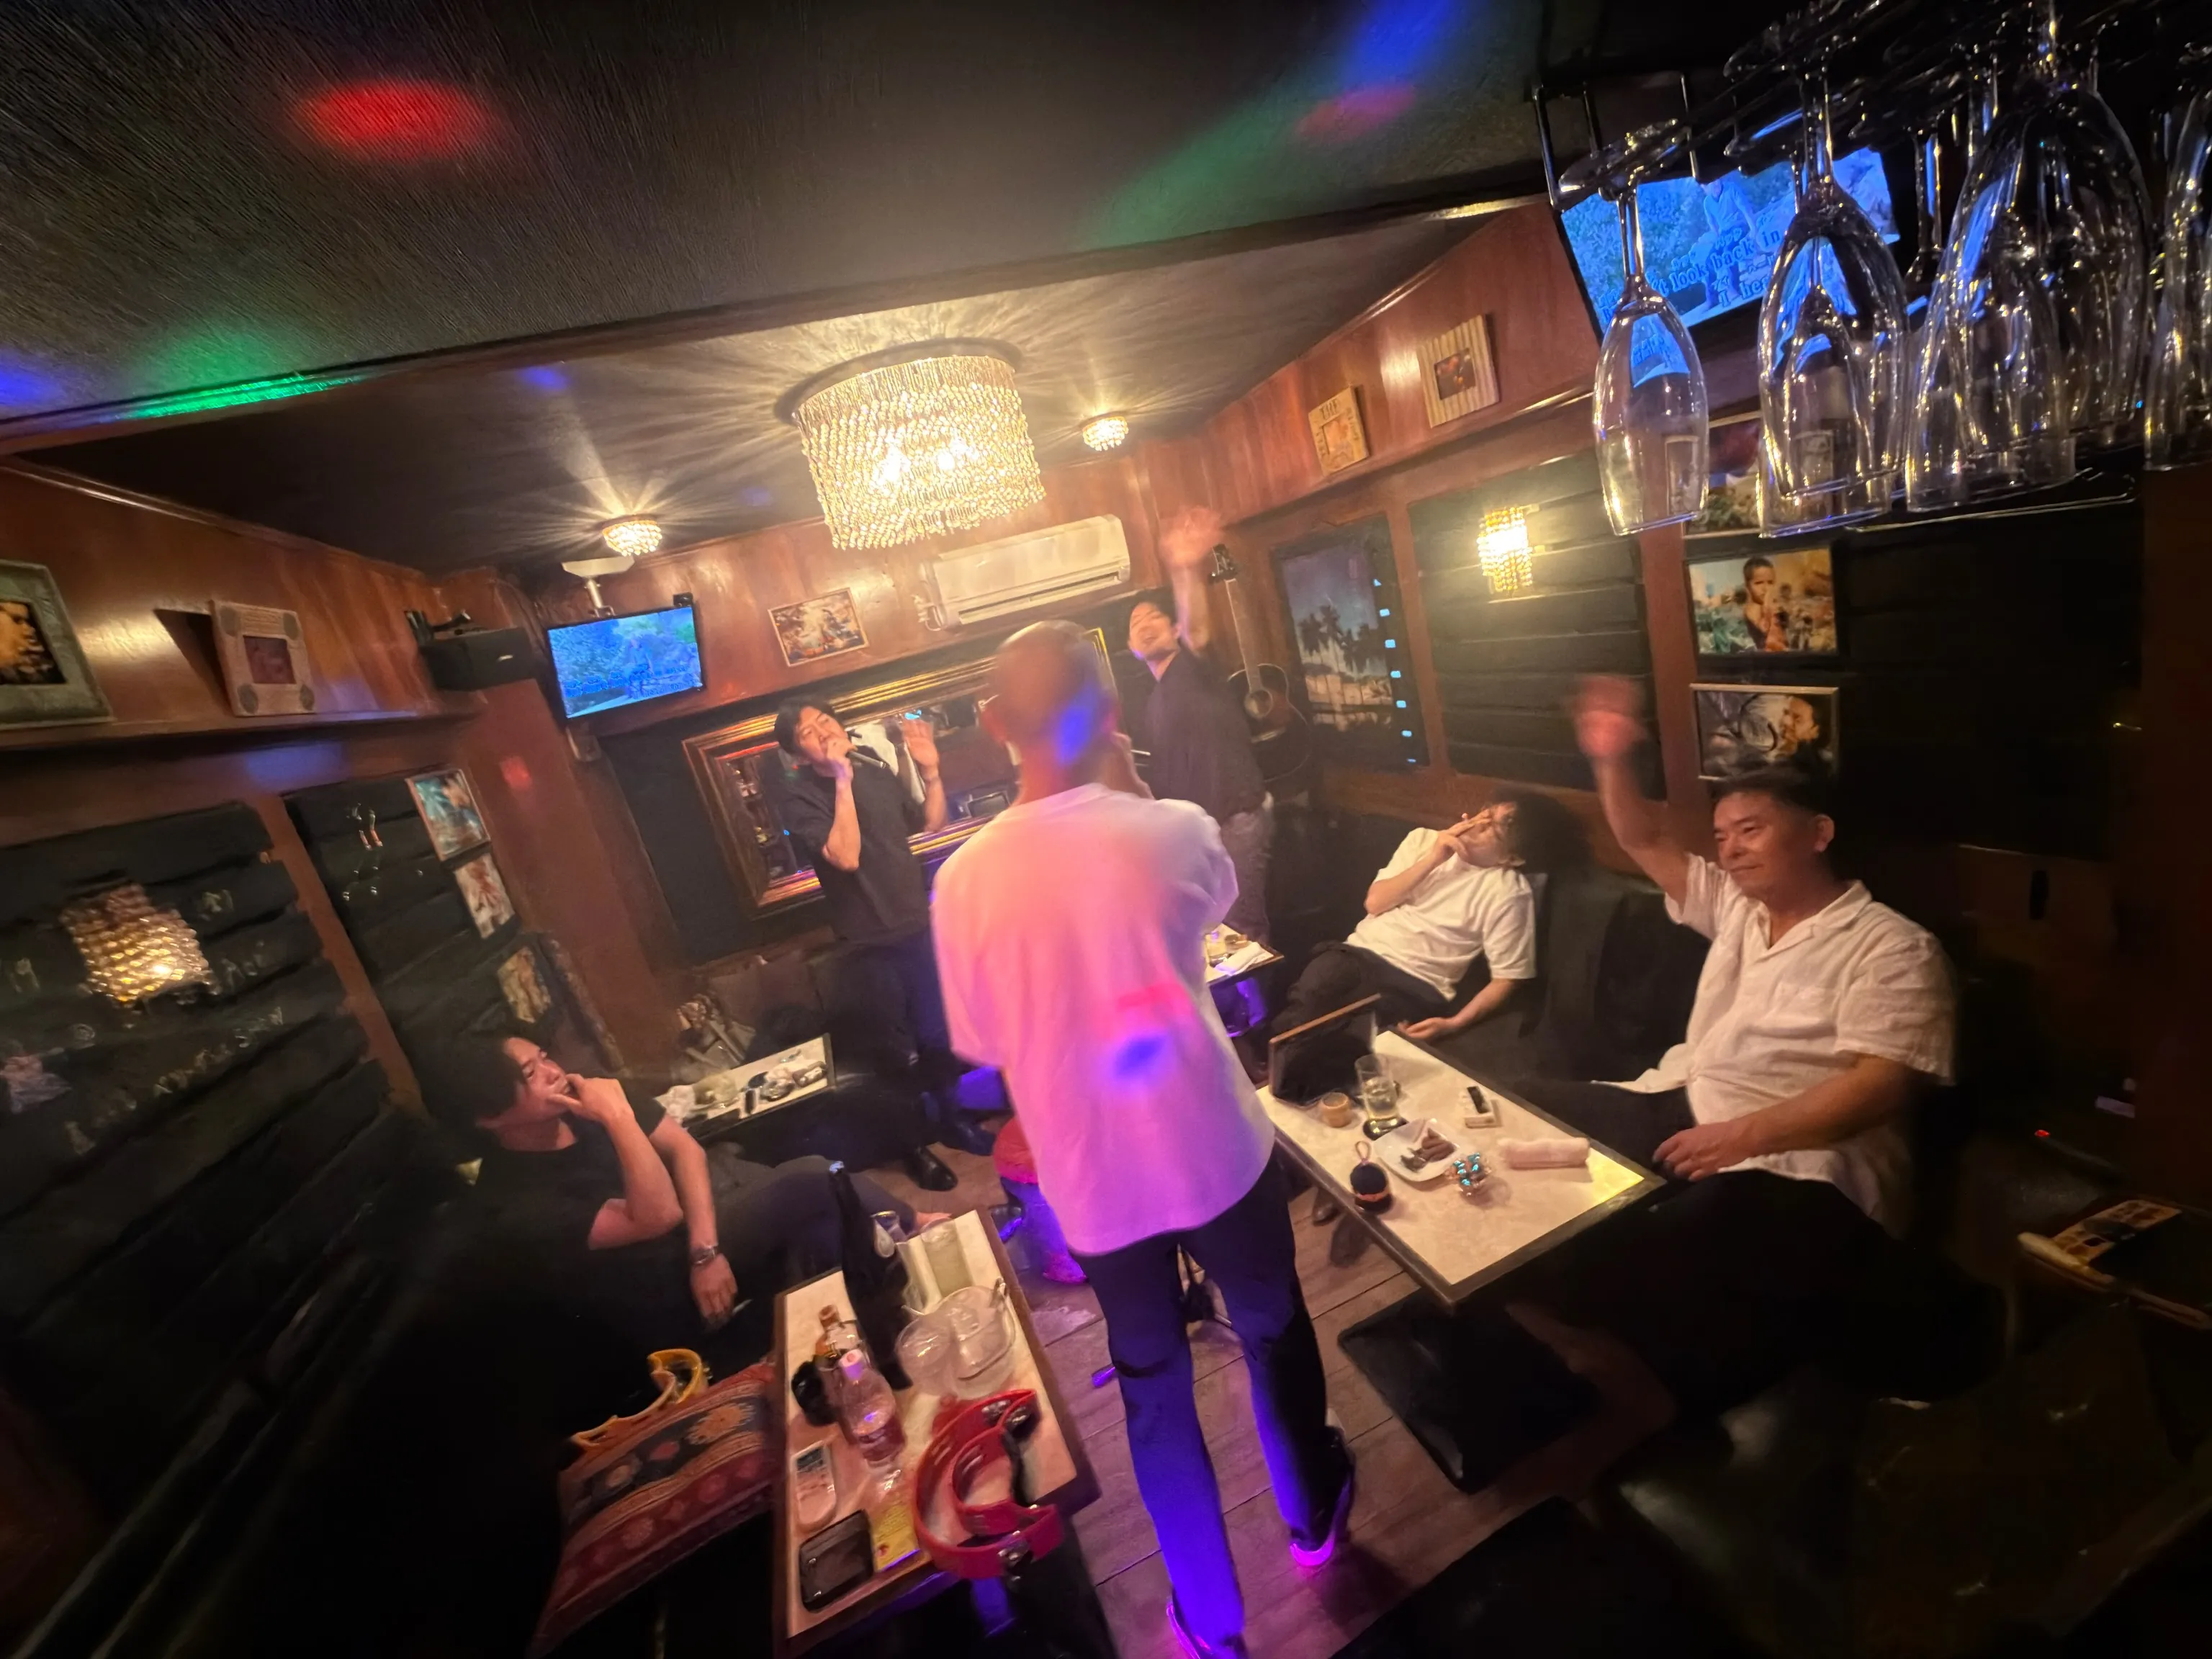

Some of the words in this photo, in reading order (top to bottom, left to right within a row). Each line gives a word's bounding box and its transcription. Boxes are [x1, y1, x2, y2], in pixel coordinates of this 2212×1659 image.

[1670, 263, 1707, 290] look
[1712, 238, 1755, 269] back
[1761, 230, 1780, 247] in
